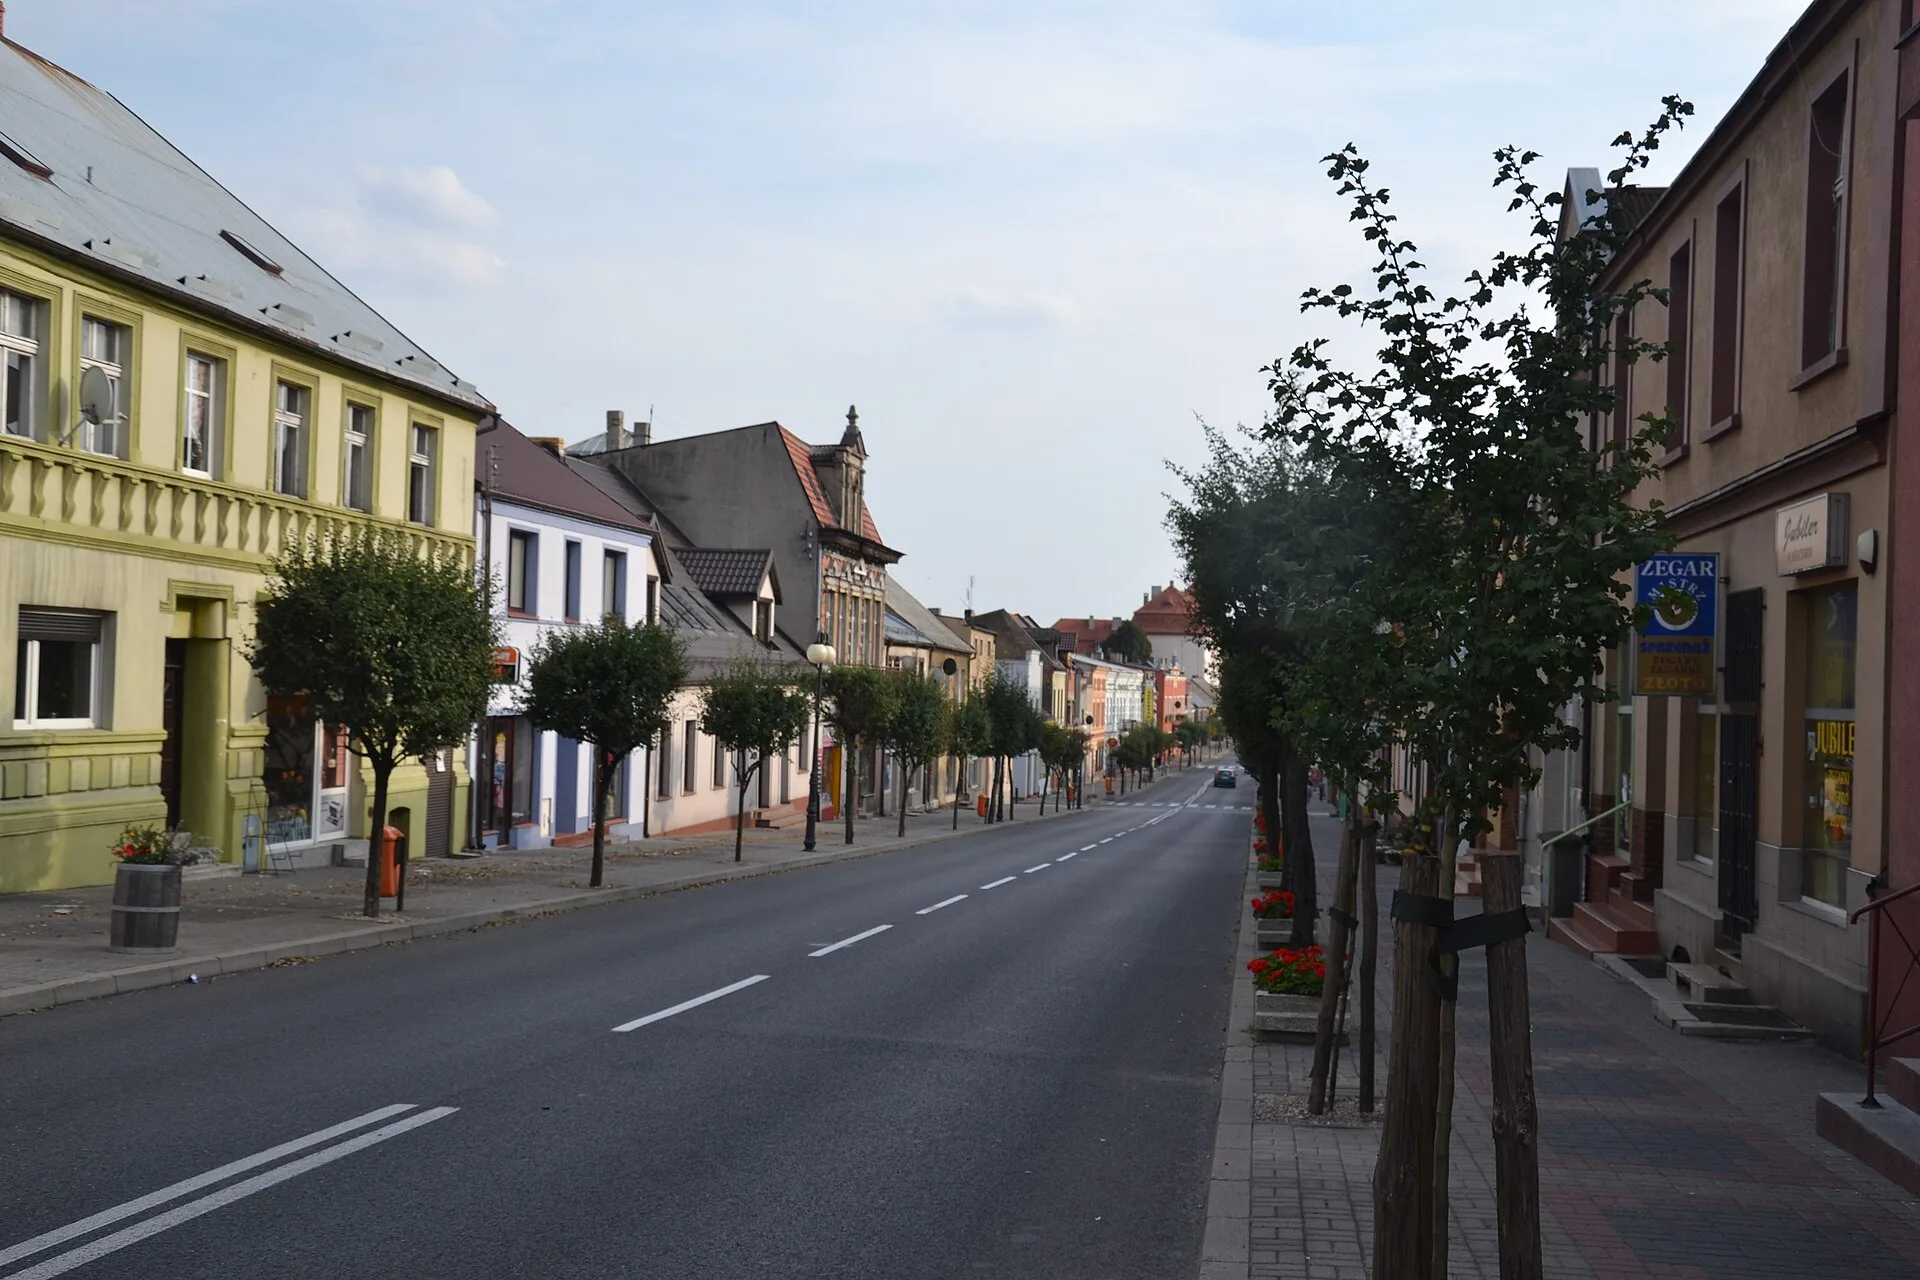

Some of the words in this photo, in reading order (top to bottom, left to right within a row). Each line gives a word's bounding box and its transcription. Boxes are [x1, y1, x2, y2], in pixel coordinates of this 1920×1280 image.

[1783, 513, 1818, 552] Jubiler
[1640, 560, 1714, 577] ZEGAR
[1643, 677, 1706, 690] ZŁOTO
